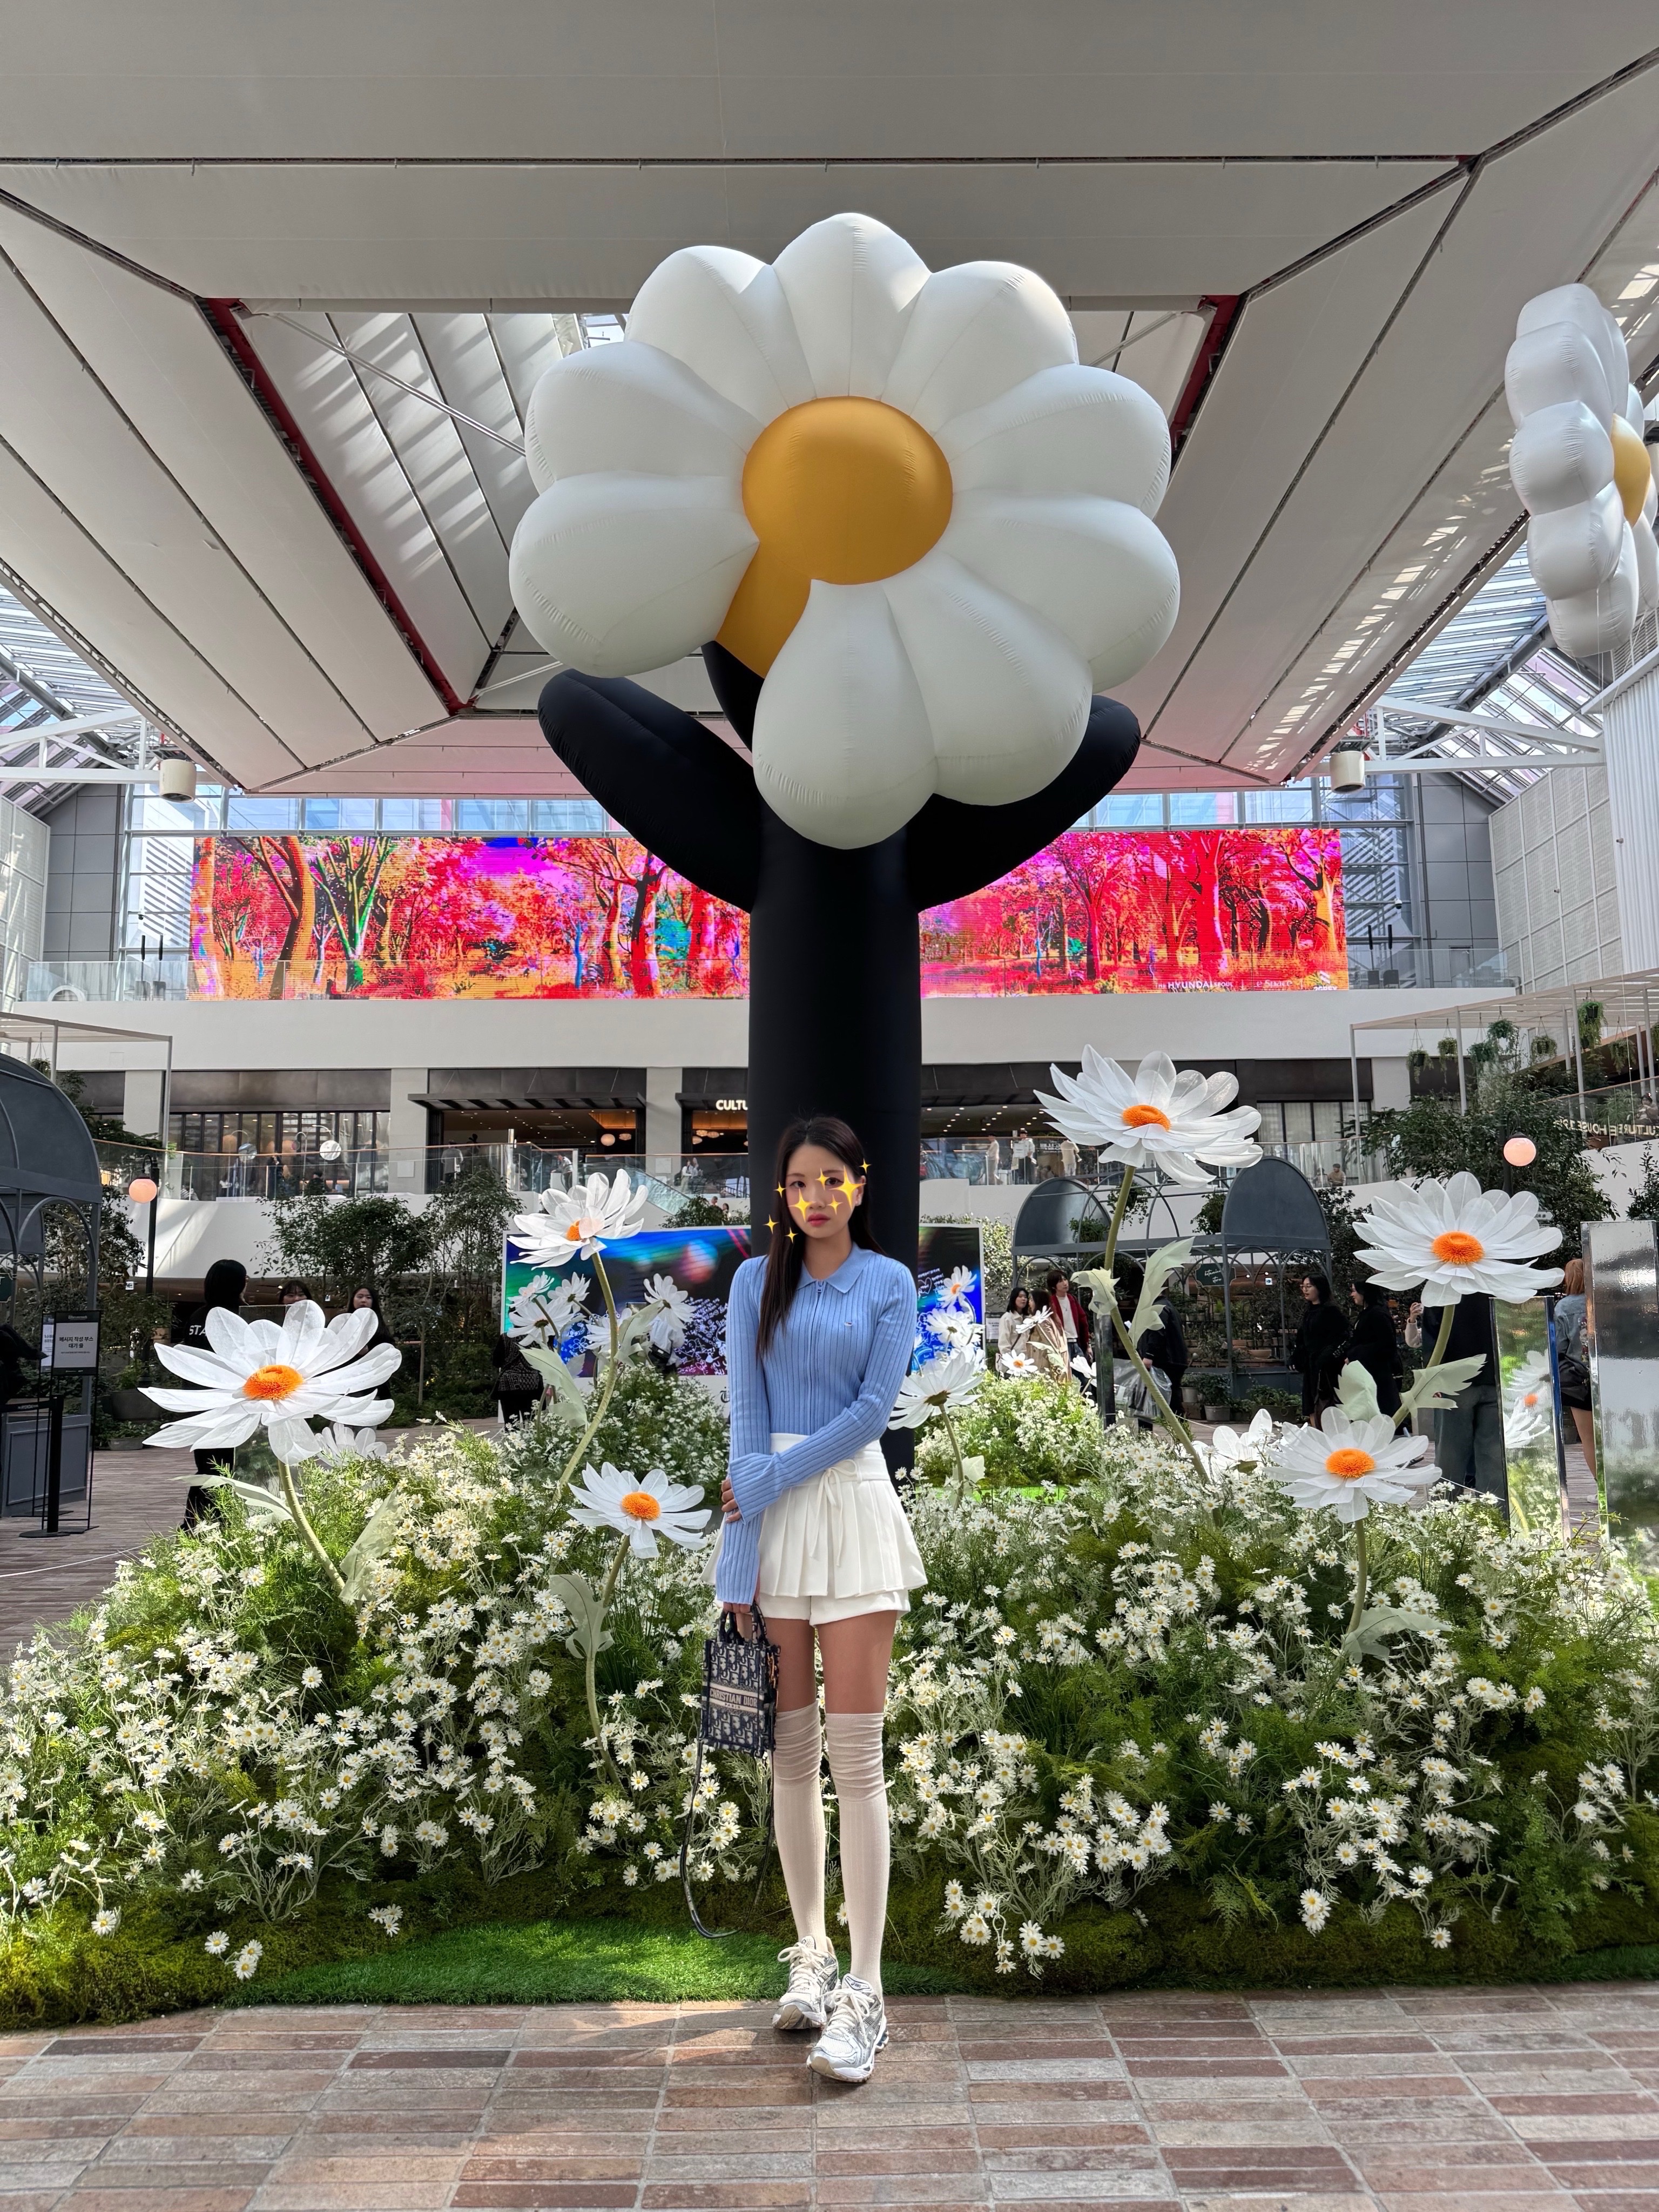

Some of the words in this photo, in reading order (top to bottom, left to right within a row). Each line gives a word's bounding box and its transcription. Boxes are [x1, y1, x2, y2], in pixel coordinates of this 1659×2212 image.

[1168, 980, 1213, 989] HYUNDAI
[709, 1688, 742, 1705] CHRISTIAN
[743, 1696, 758, 1708] DIOR
